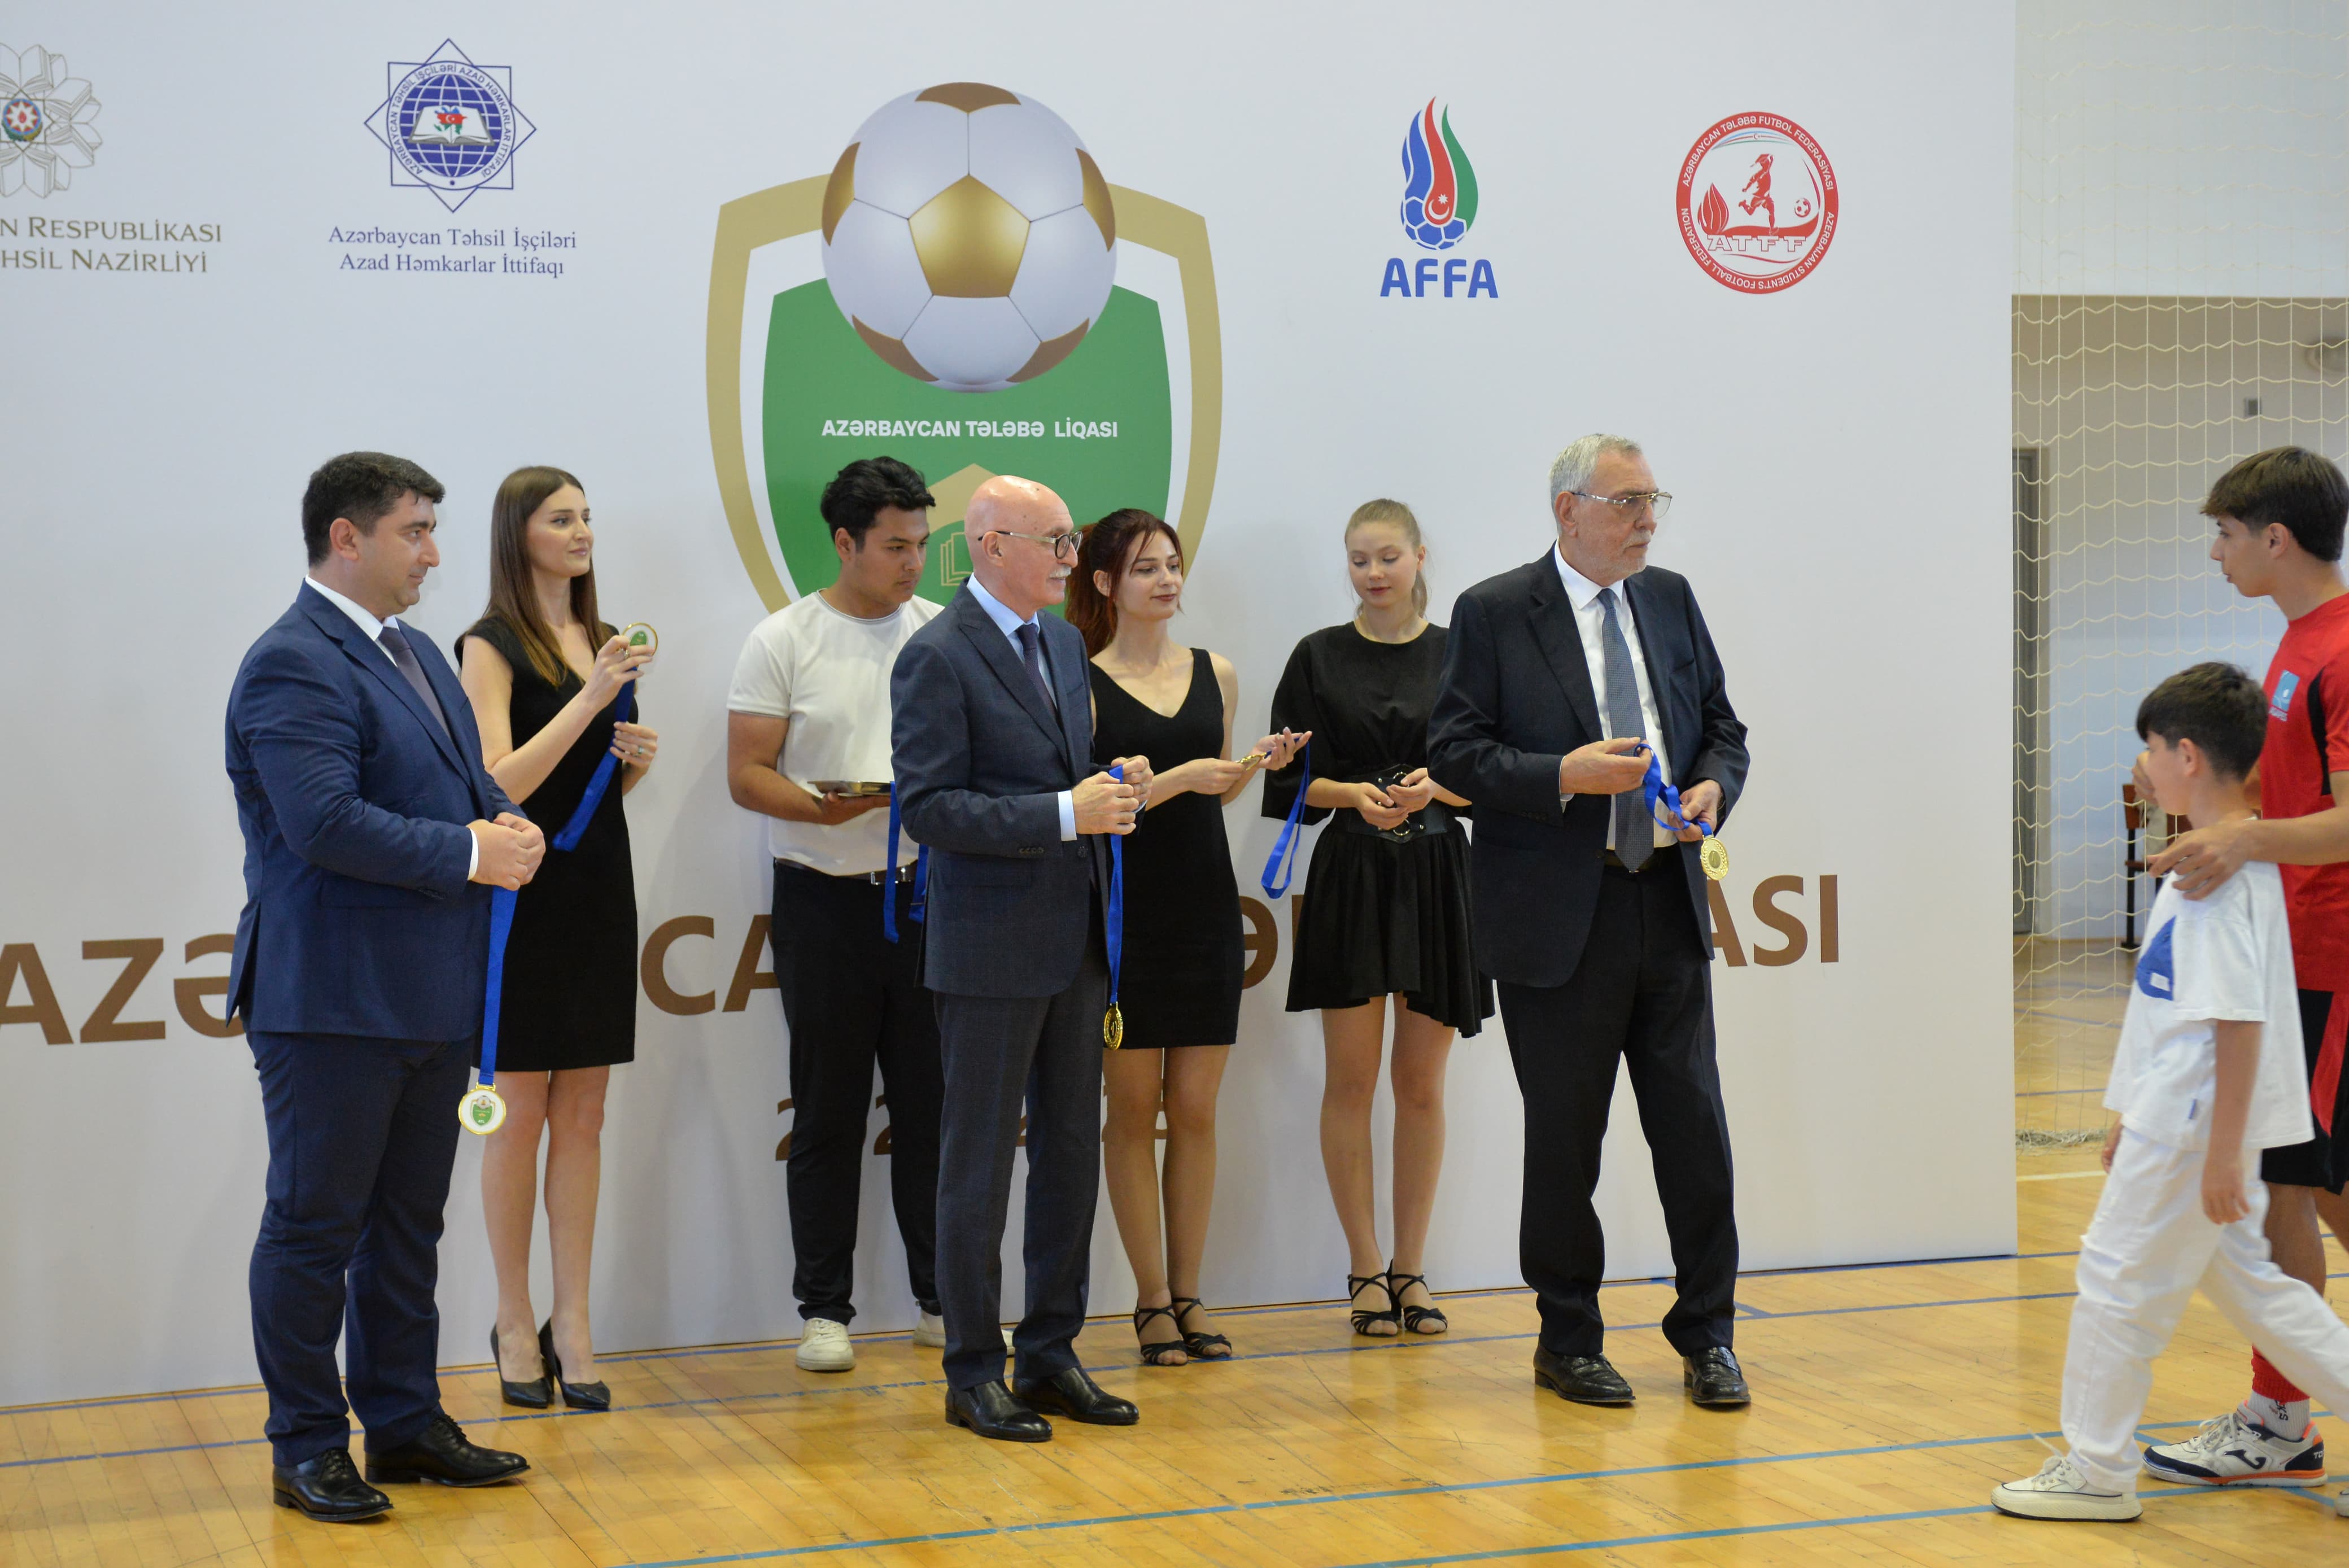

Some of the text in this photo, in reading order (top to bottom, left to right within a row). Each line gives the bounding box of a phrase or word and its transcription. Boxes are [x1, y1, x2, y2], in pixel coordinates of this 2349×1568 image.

[459, 66, 485, 84] AZAD
[486, 81, 512, 141] HƏMKARLAR
[1682, 115, 1834, 190] AZƏRBAYCAN TƏLƏBƏ FUTBOL FEDERASİYASI
[328, 226, 577, 251] Azərbaycan Təhsil İşçiləri
[1681, 207, 1711, 267] FEDERATION
[1707, 234, 1806, 252] ATFF
[1804, 211, 1835, 269] AZERBAIJAN
[1, 247, 208, 273] HSİL NAZİRLİYİ
[339, 252, 565, 278] Azad Həmkarlar İttifaqı
[1380, 257, 1499, 299] AFFA
[1711, 263, 1756, 290] FOOTBALL
[822, 417, 1118, 439] AZƏRBAYCAN TƏLƏBƏ LİQASI
